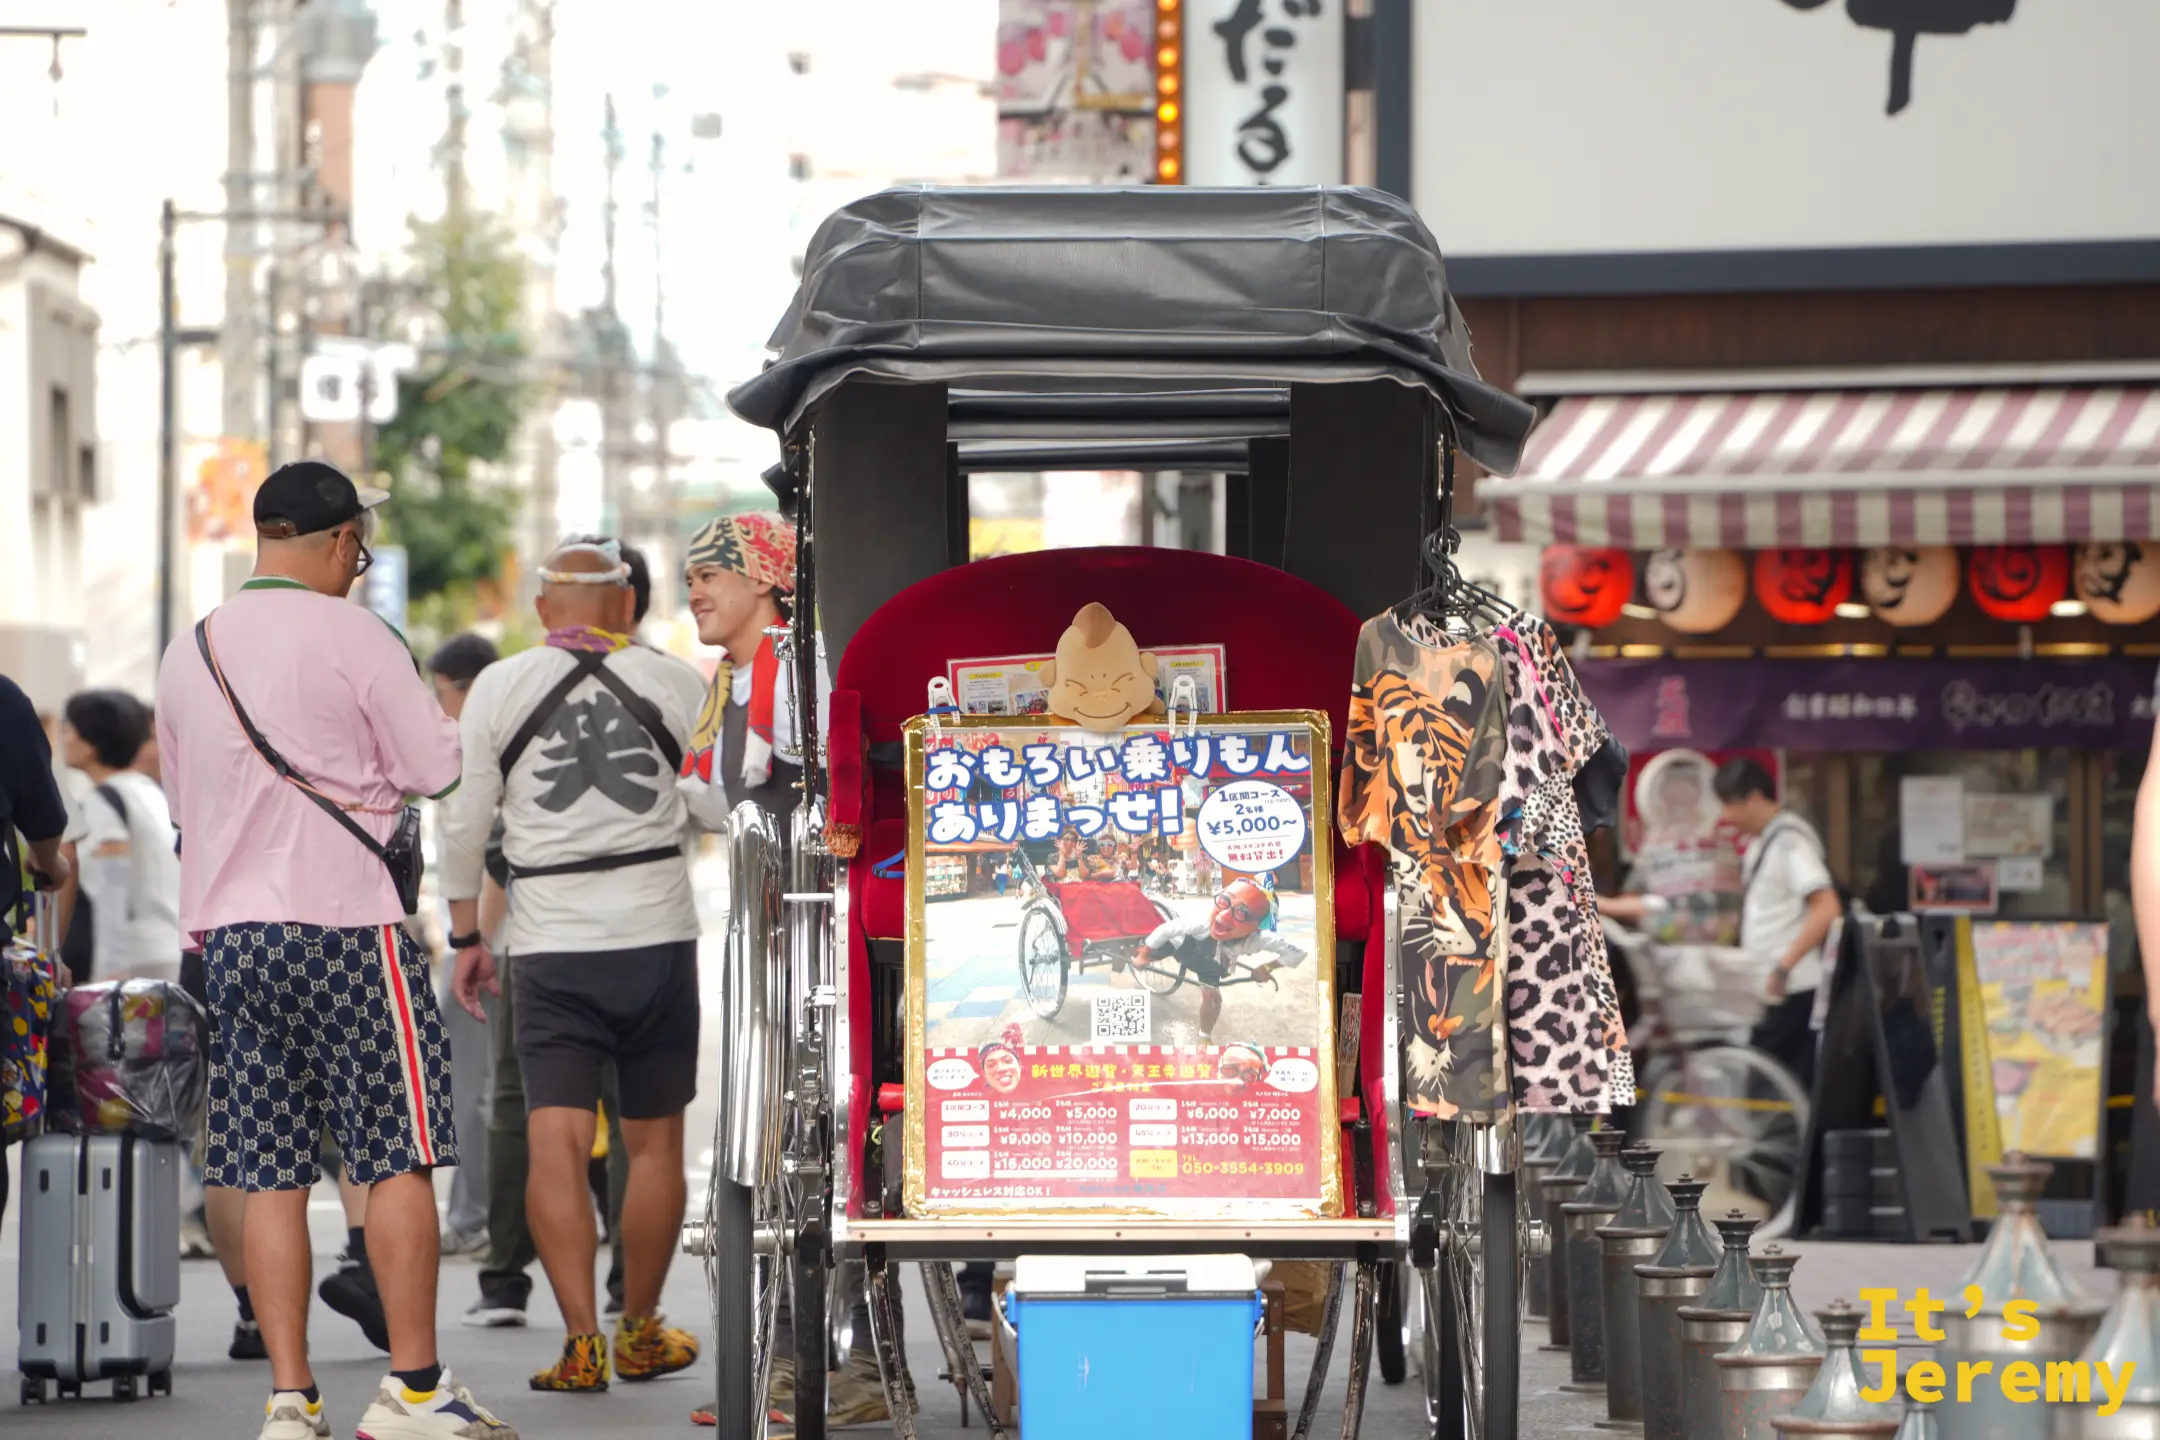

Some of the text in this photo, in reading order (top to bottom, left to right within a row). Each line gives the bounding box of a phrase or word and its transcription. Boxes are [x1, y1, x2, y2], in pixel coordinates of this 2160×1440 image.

[1213, 0, 1322, 185] だる
[532, 689, 660, 816] 笑
[926, 731, 1311, 792] おもろい乗りもん
[1218, 789, 1280, 803] 1区間コース
[928, 786, 1184, 844] ありまっせ!
[1234, 803, 1263, 815] 2名様
[1000, 1107, 1051, 1120] ¥4,000
[1067, 1107, 1117, 1120] ¥5,000
[1187, 1107, 1239, 1120] ¥6,000
[1250, 1108, 1301, 1121] ¥7,000
[1000, 1132, 1051, 1145] ¥9,000
[1059, 1132, 1117, 1145] ¥10,000
[1182, 1132, 1239, 1146] ¥13,000
[1244, 1133, 1301, 1146] ¥15,000
[994, 1157, 1052, 1170] ¥16,000
[1056, 1157, 1118, 1170] ¥20,000
[1182, 1162, 1304, 1175] 050-3554-3909
